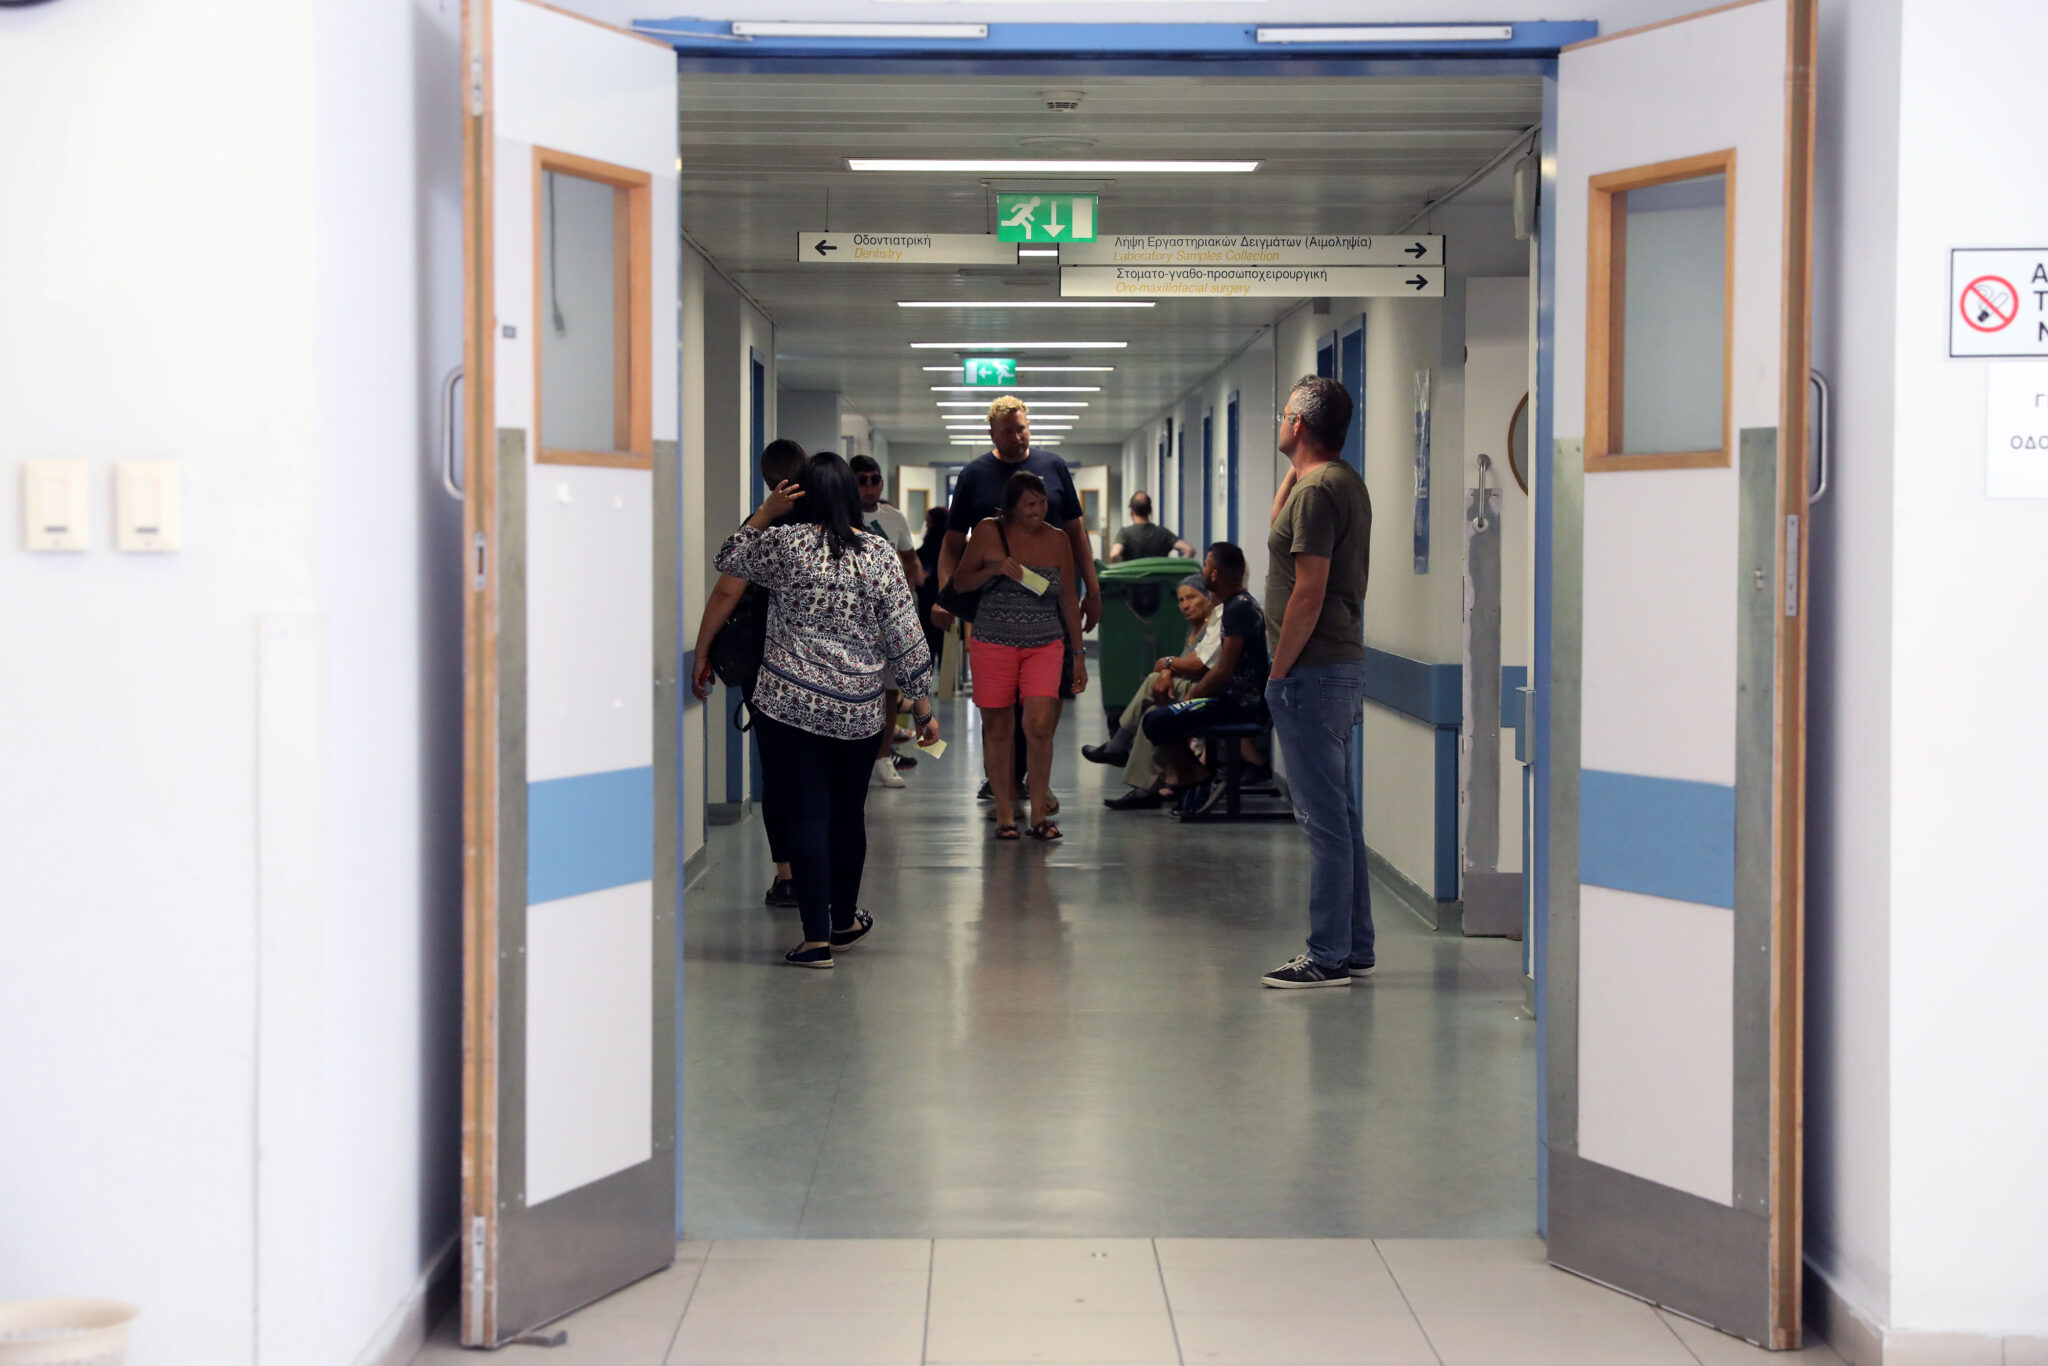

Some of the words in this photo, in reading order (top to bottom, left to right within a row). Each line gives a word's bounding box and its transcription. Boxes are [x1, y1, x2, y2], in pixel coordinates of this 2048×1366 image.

[853, 234, 931, 248] Οδοντιατρική
[1114, 236, 1145, 250] Λήψη
[1147, 236, 1237, 250] Εργαστηριακών
[1240, 236, 1302, 250] Δειγμάτων
[1305, 236, 1372, 250] (Αιμοληψία)
[854, 247, 902, 261] Dentistry
[1113, 250, 1173, 263] Laboratory
[1175, 250, 1222, 263] Samples
[1225, 250, 1280, 262] Collection
[1116, 281, 1208, 294] Oro-maxillofacial
[1210, 284, 1250, 296] surgery
